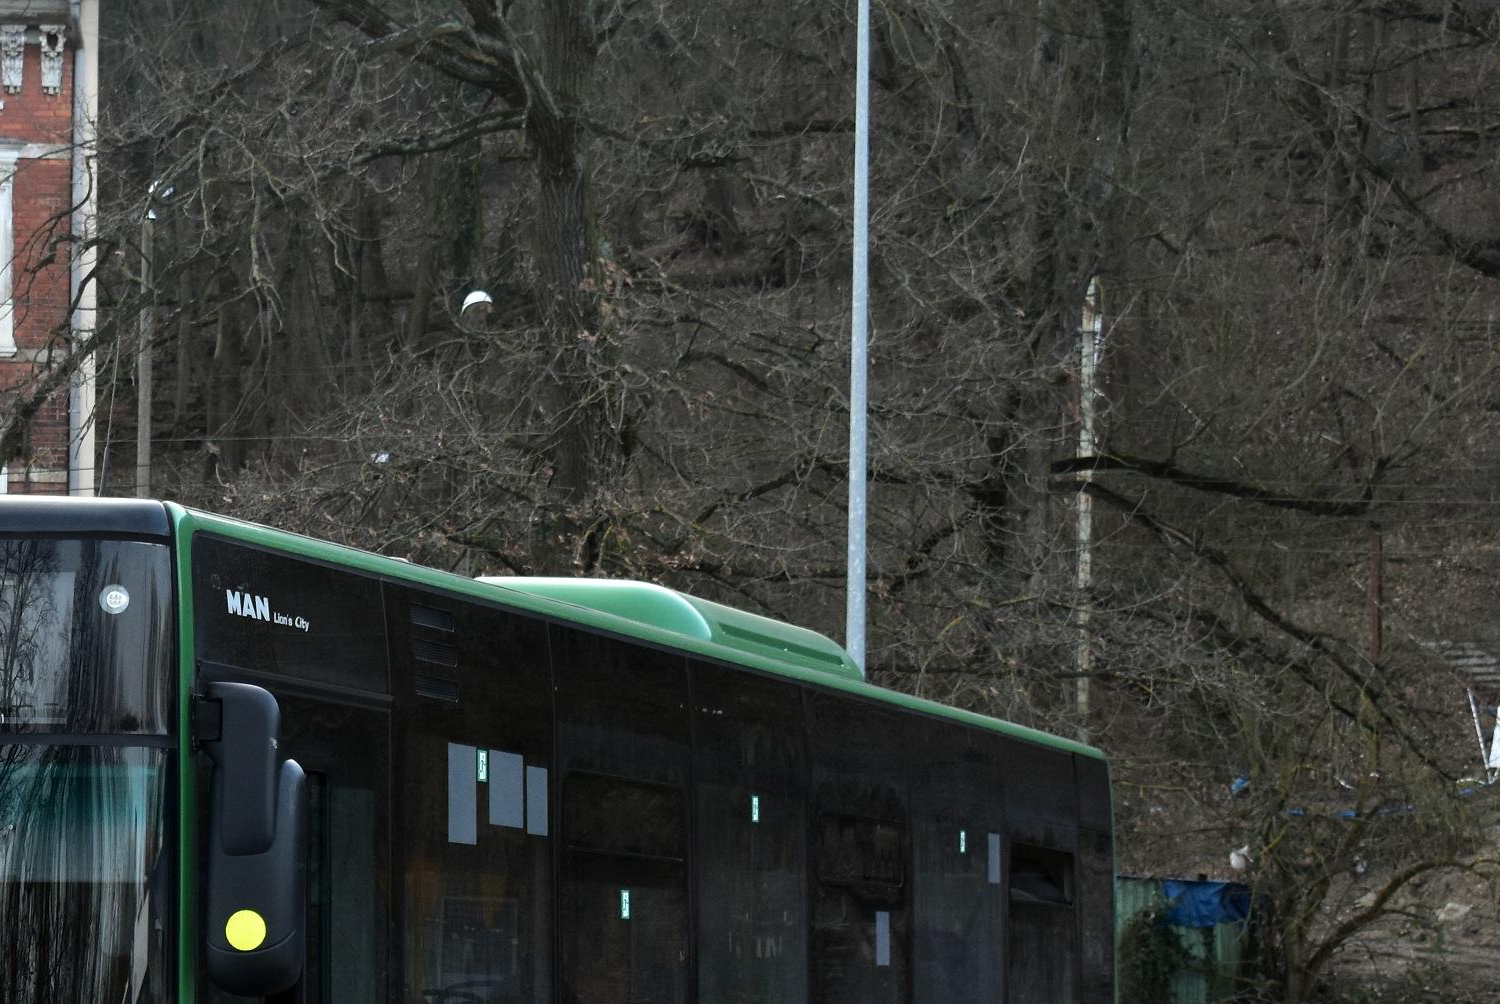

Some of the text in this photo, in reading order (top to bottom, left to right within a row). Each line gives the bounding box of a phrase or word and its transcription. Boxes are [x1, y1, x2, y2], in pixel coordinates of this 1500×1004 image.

[226, 589, 309, 632] MAN Lion's City
